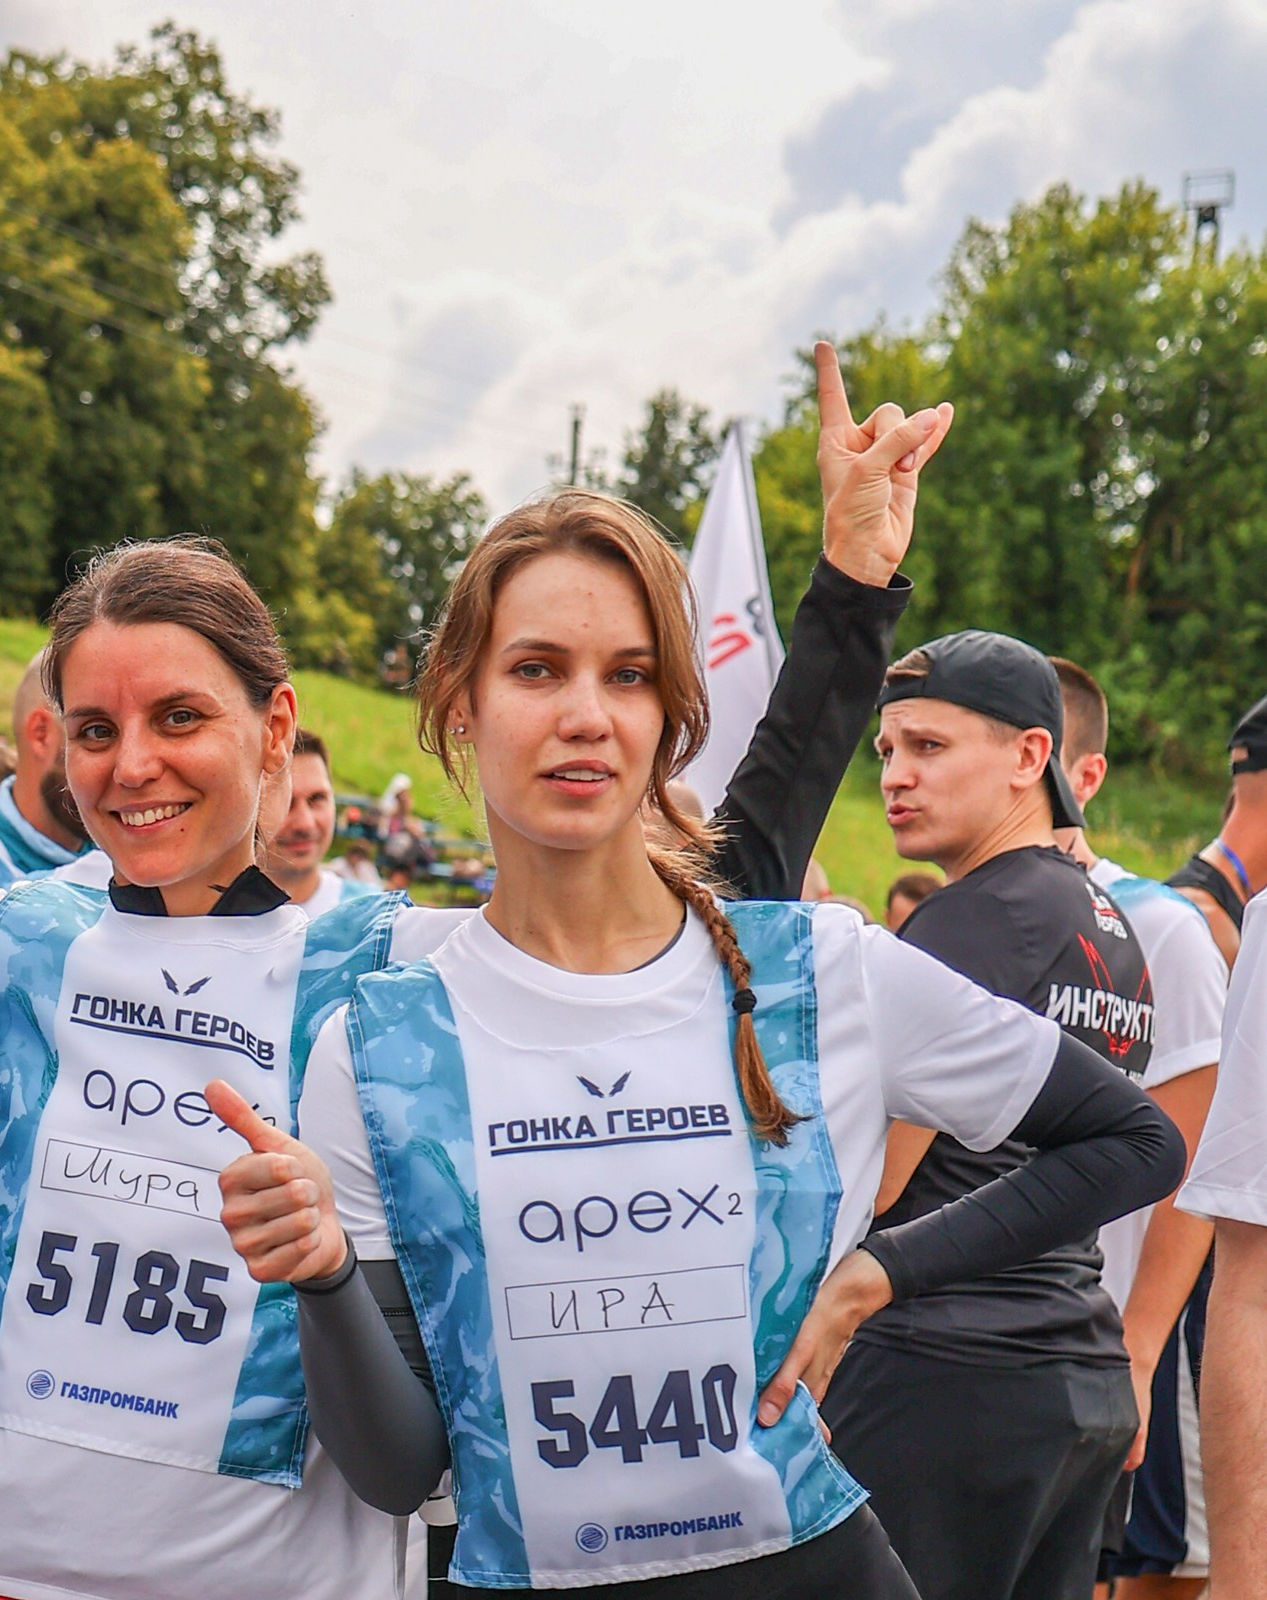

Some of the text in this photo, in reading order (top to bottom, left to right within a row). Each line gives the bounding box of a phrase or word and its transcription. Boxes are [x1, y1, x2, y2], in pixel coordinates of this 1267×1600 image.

[71, 993, 275, 1061] ГОНКА ГЕРОЕВ
[488, 1103, 730, 1147] ГОНКА ГЕРОЕВ
[518, 1183, 725, 1253] apex
[25, 1230, 230, 1346] 5185
[549, 1281, 675, 1331] ИРА
[59, 1381, 180, 1420] ГАЗПРОМБАНК
[530, 1363, 739, 1470] 5440
[613, 1510, 744, 1543] ГАЗПРОМБАНК
